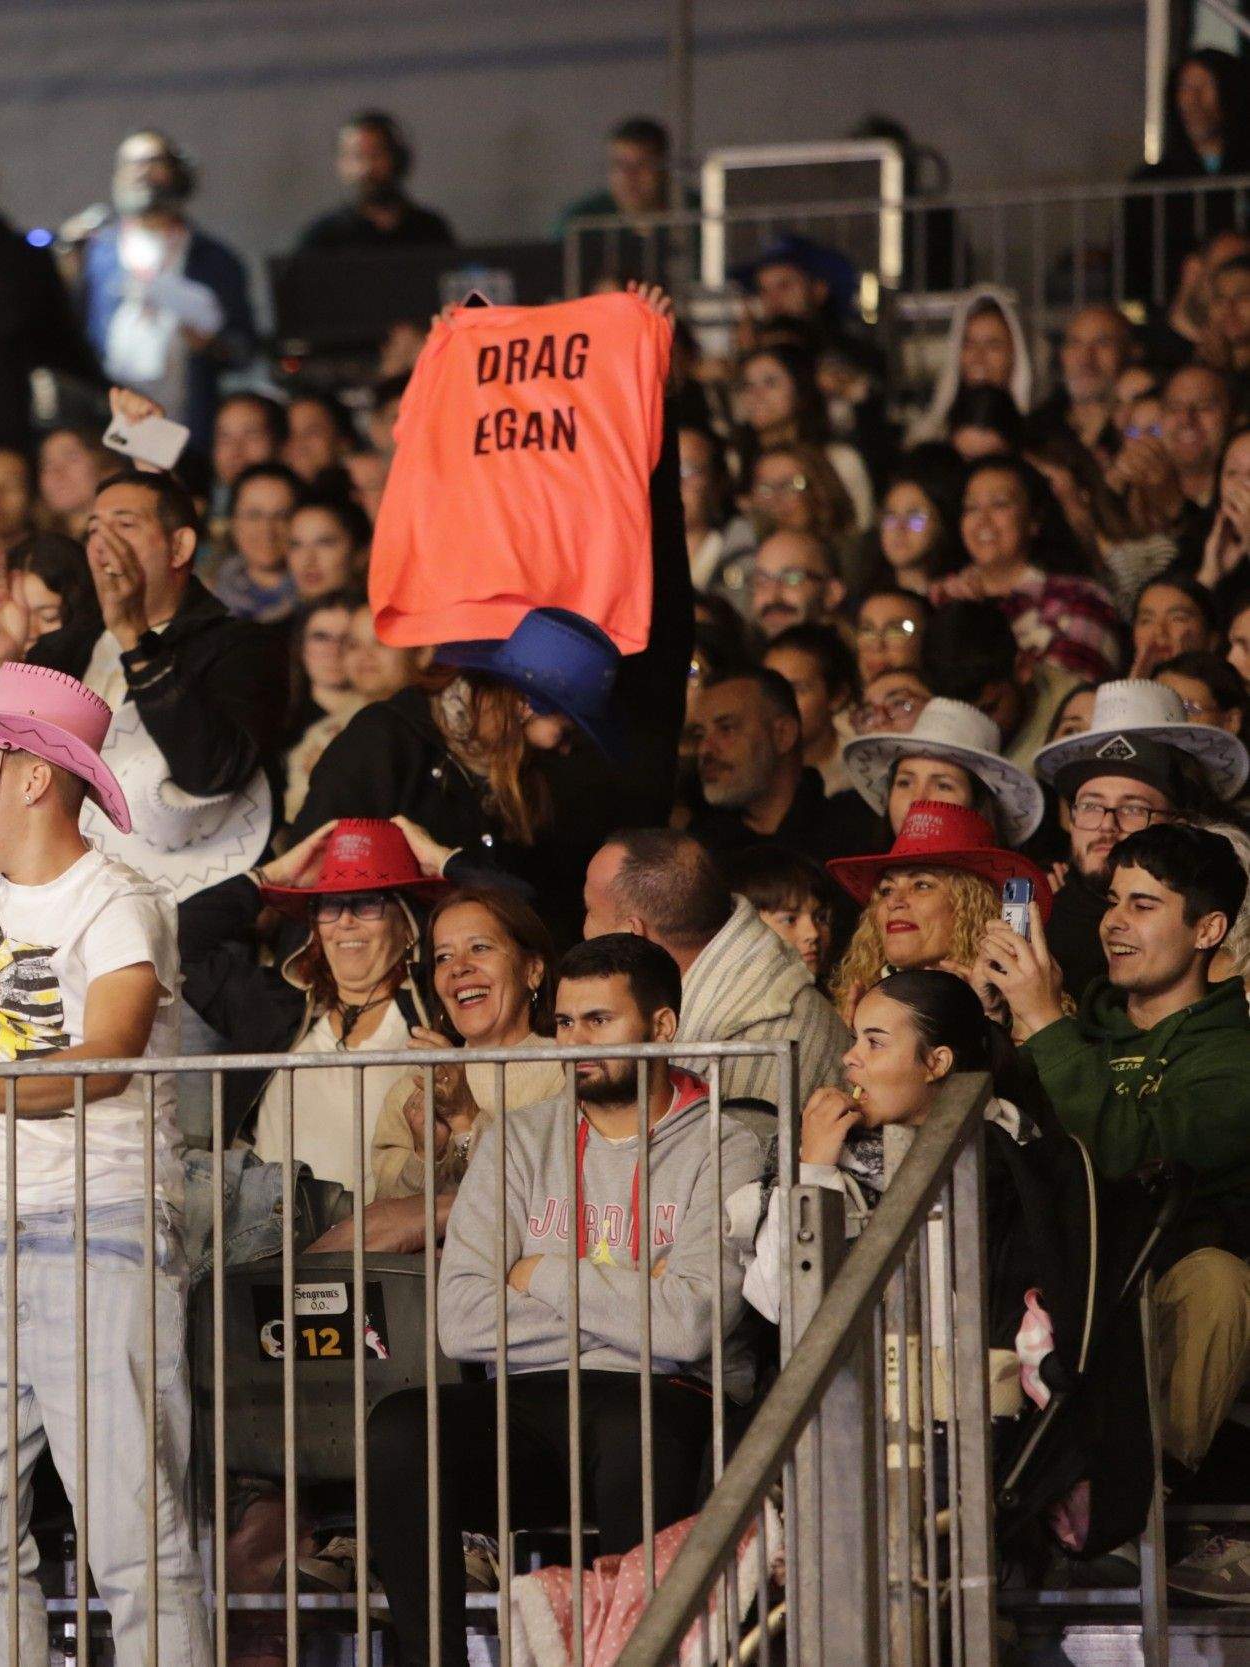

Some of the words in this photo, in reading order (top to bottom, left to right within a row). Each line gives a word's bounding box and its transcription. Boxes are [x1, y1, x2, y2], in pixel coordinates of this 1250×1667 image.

[477, 333, 590, 386] DRAG
[474, 406, 577, 456] EGAN
[529, 1197, 676, 1247] JORDN
[294, 1287, 340, 1301] Seagram's
[302, 1327, 342, 1357] 12
